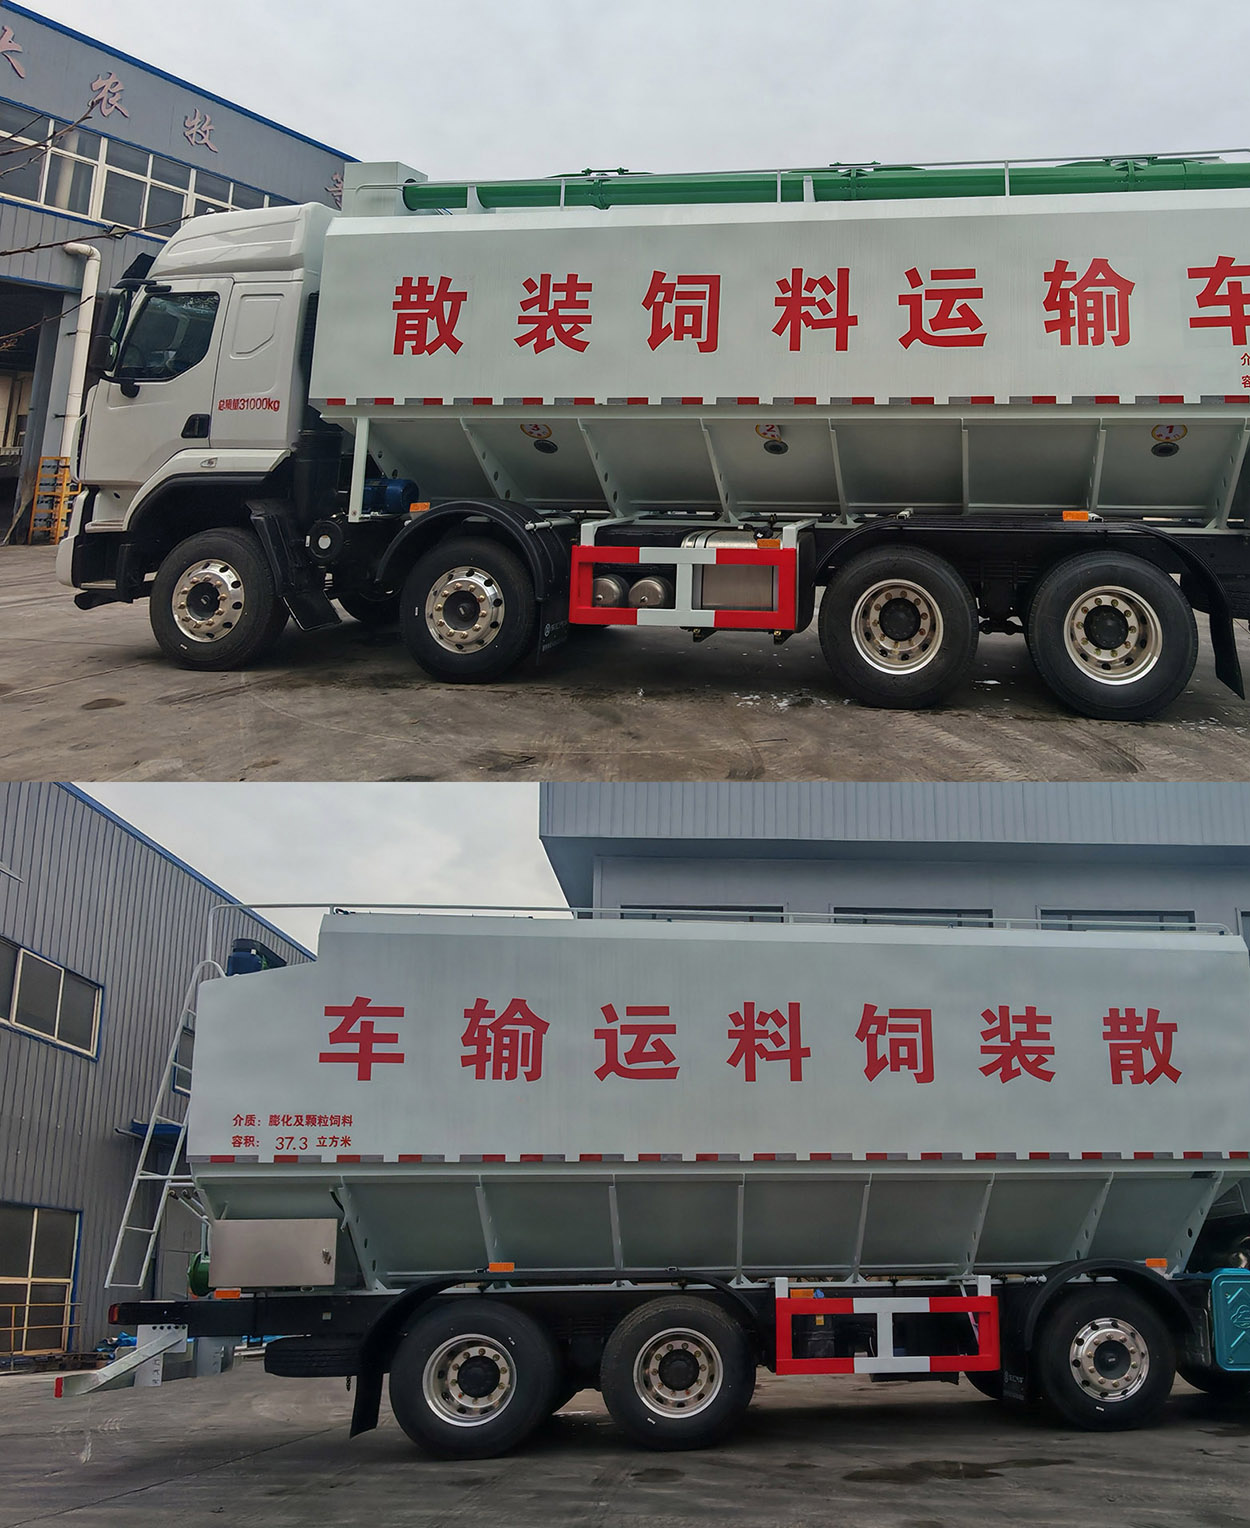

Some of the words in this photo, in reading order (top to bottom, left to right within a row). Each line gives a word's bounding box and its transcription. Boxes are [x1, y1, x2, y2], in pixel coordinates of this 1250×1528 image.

[275, 1136, 308, 1151] 37.3
[316, 1135, 352, 1148] 立方米
